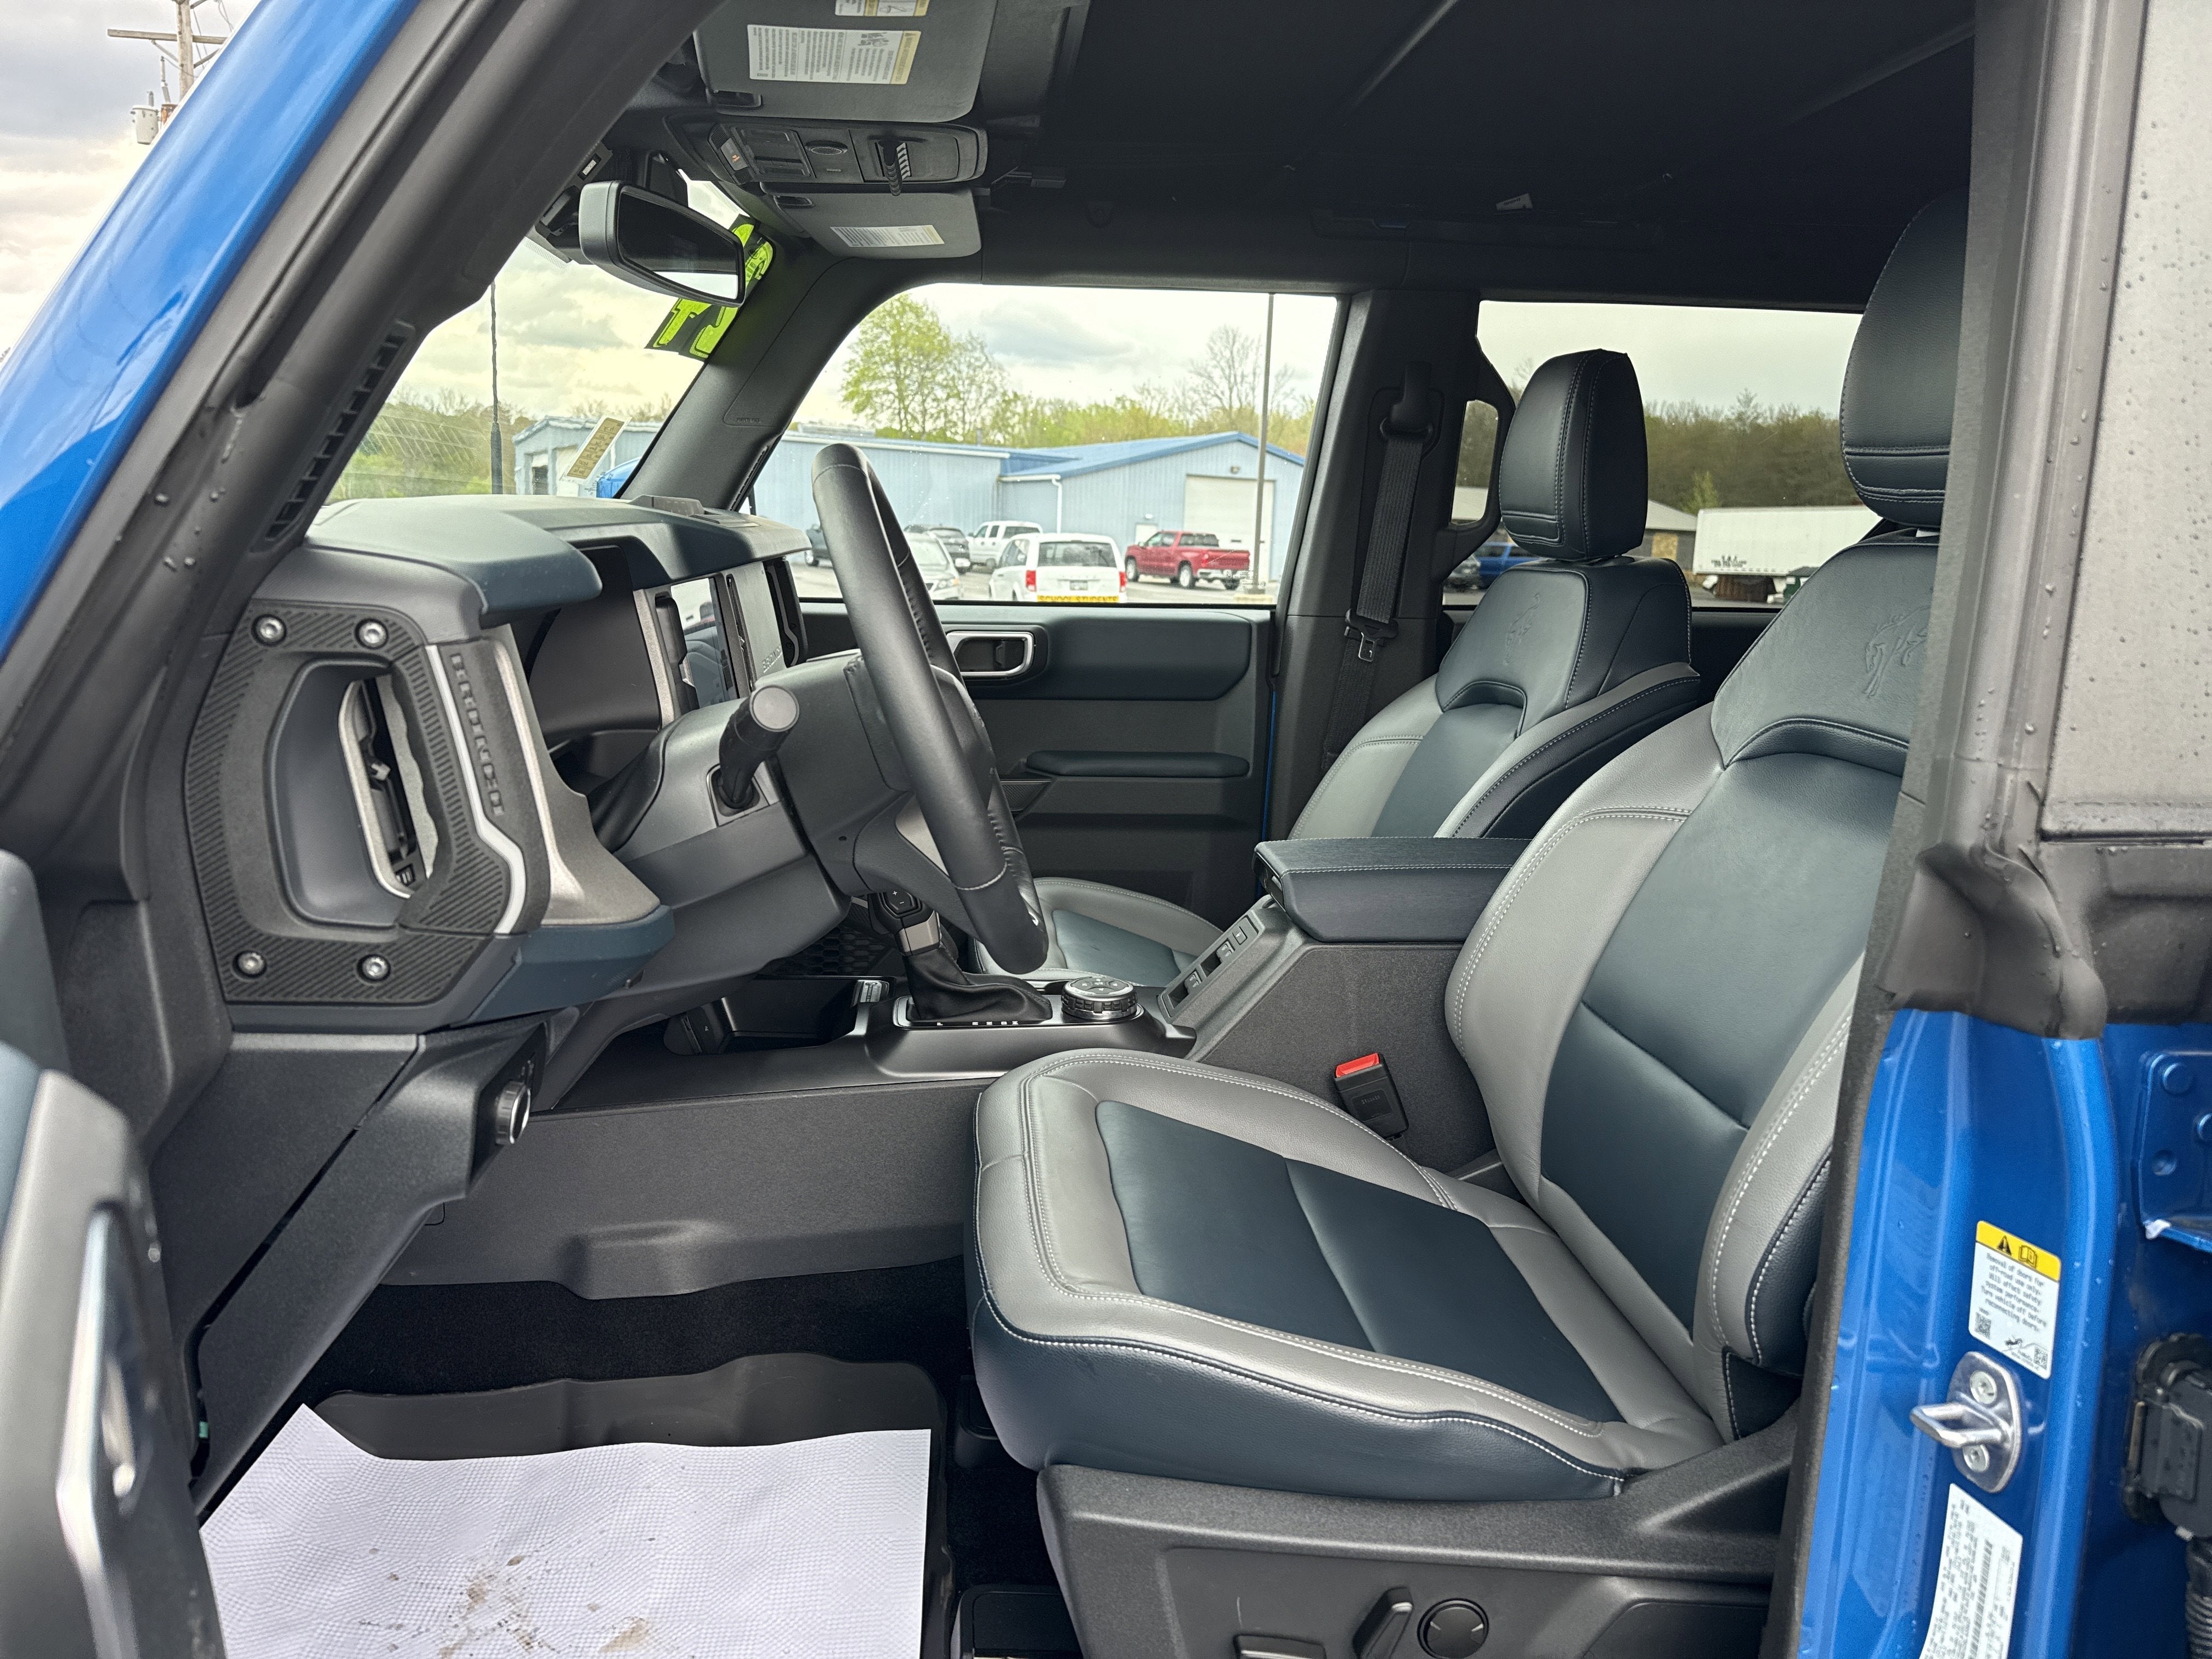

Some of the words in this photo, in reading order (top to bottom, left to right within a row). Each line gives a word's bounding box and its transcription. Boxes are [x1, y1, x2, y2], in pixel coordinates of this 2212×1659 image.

[450, 653, 505, 816] BRONCO
[1986, 1252, 2006, 1268] Removal
[2008, 1263, 2015, 1272] of
[2017, 1268, 2032, 1282] doors
[1989, 1263, 2012, 1280] off-road
[2015, 1277, 2024, 1286] use
[1985, 1280, 2002, 1294] system
[1989, 1272, 2000, 1283] Will
[2002, 1279, 2021, 1294] affect
[2022, 1290, 2041, 1308] safety
[1981, 1285, 1992, 1297] Turn
[1994, 1293, 2015, 1310] vehicle
[2016, 1305, 2025, 1315] off
[2028, 1311, 2046, 1327] before
[1985, 1297, 2019, 1322] reconnecting
